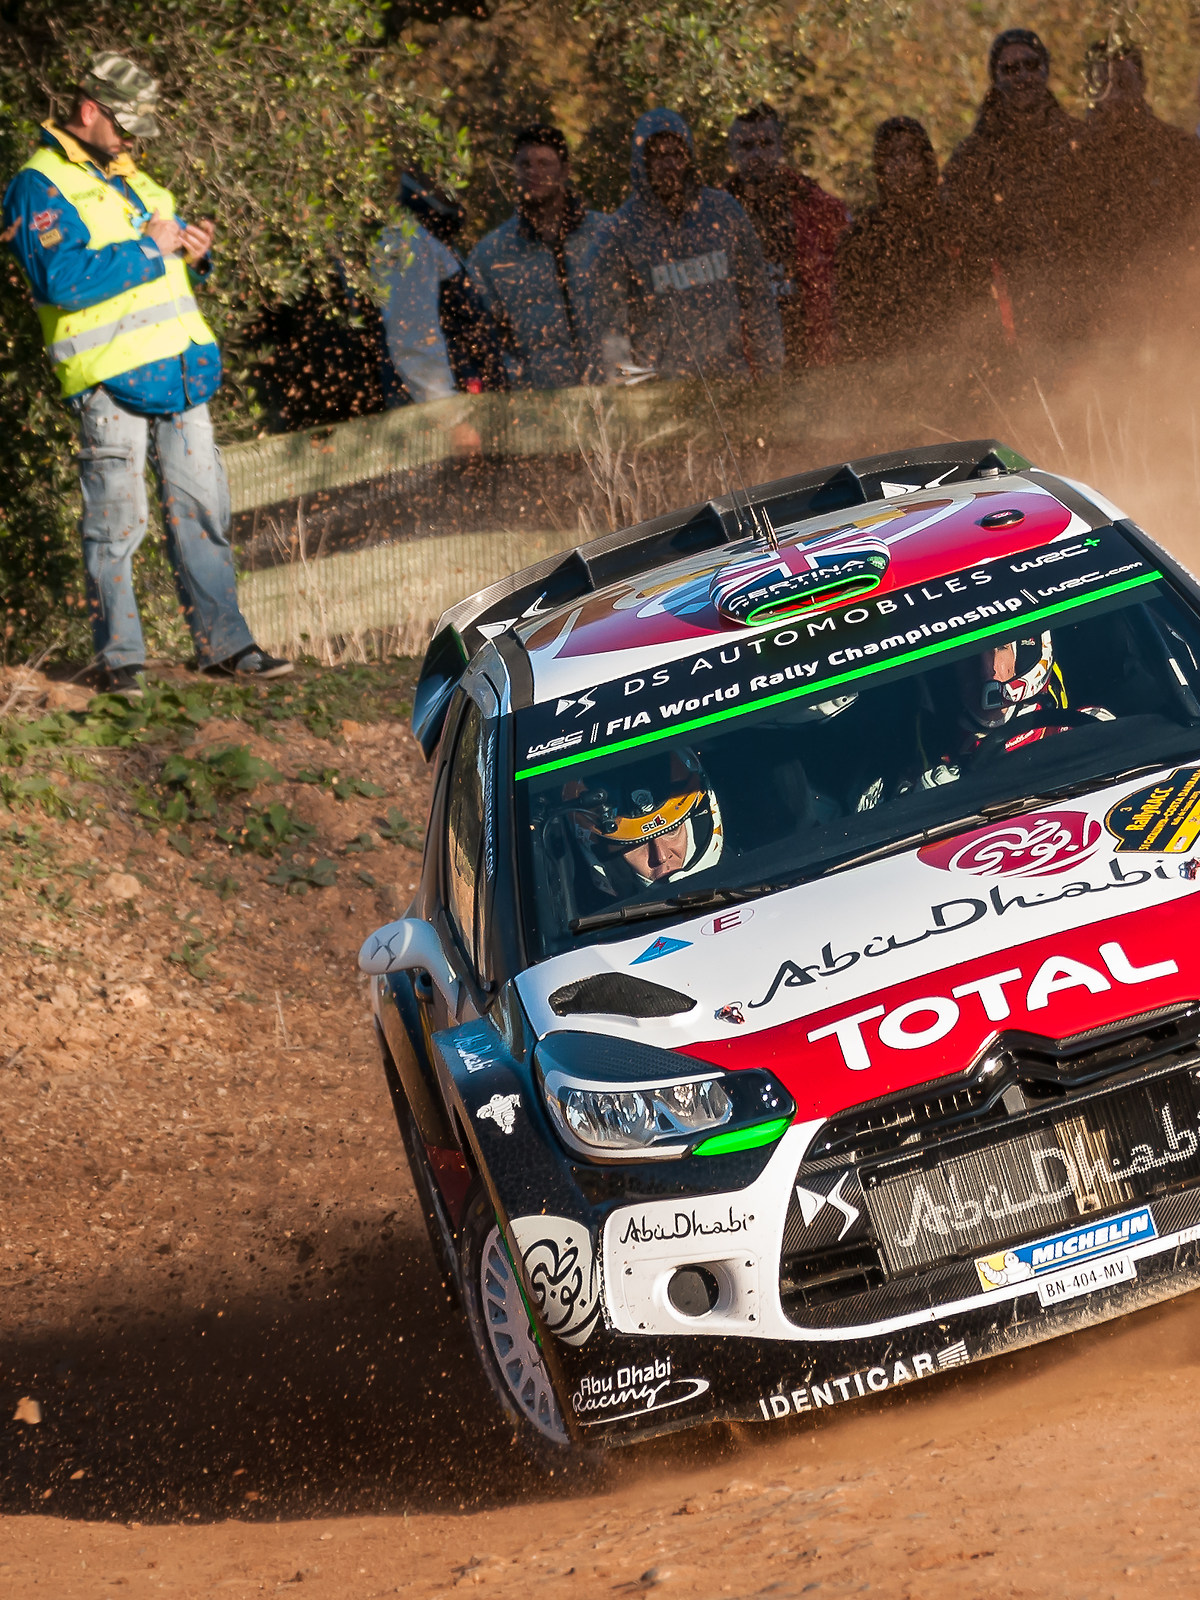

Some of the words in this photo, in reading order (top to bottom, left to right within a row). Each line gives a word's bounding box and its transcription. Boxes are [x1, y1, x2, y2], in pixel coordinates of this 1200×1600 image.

[729, 560, 865, 611] CERTINA
[623, 669, 670, 696] DS
[690, 570, 992, 675] AUTOMOBILES
[606, 711, 651, 736] FIA
[659, 683, 740, 719] World
[750, 661, 819, 692] Rally
[828, 597, 1022, 666] Championship
[1125, 786, 1174, 831] RallyRACC
[713, 911, 742, 934] E
[807, 942, 1179, 1071] TOTAL
[1032, 1213, 1149, 1266] MICHELIN
[1045, 1261, 1125, 1298] BN-404-MV
[572, 1379, 671, 1413] Racing
[580, 1377, 612, 1397] Abu
[617, 1356, 671, 1390] Dhabi
[759, 1352, 936, 1421] IDENTICAR
